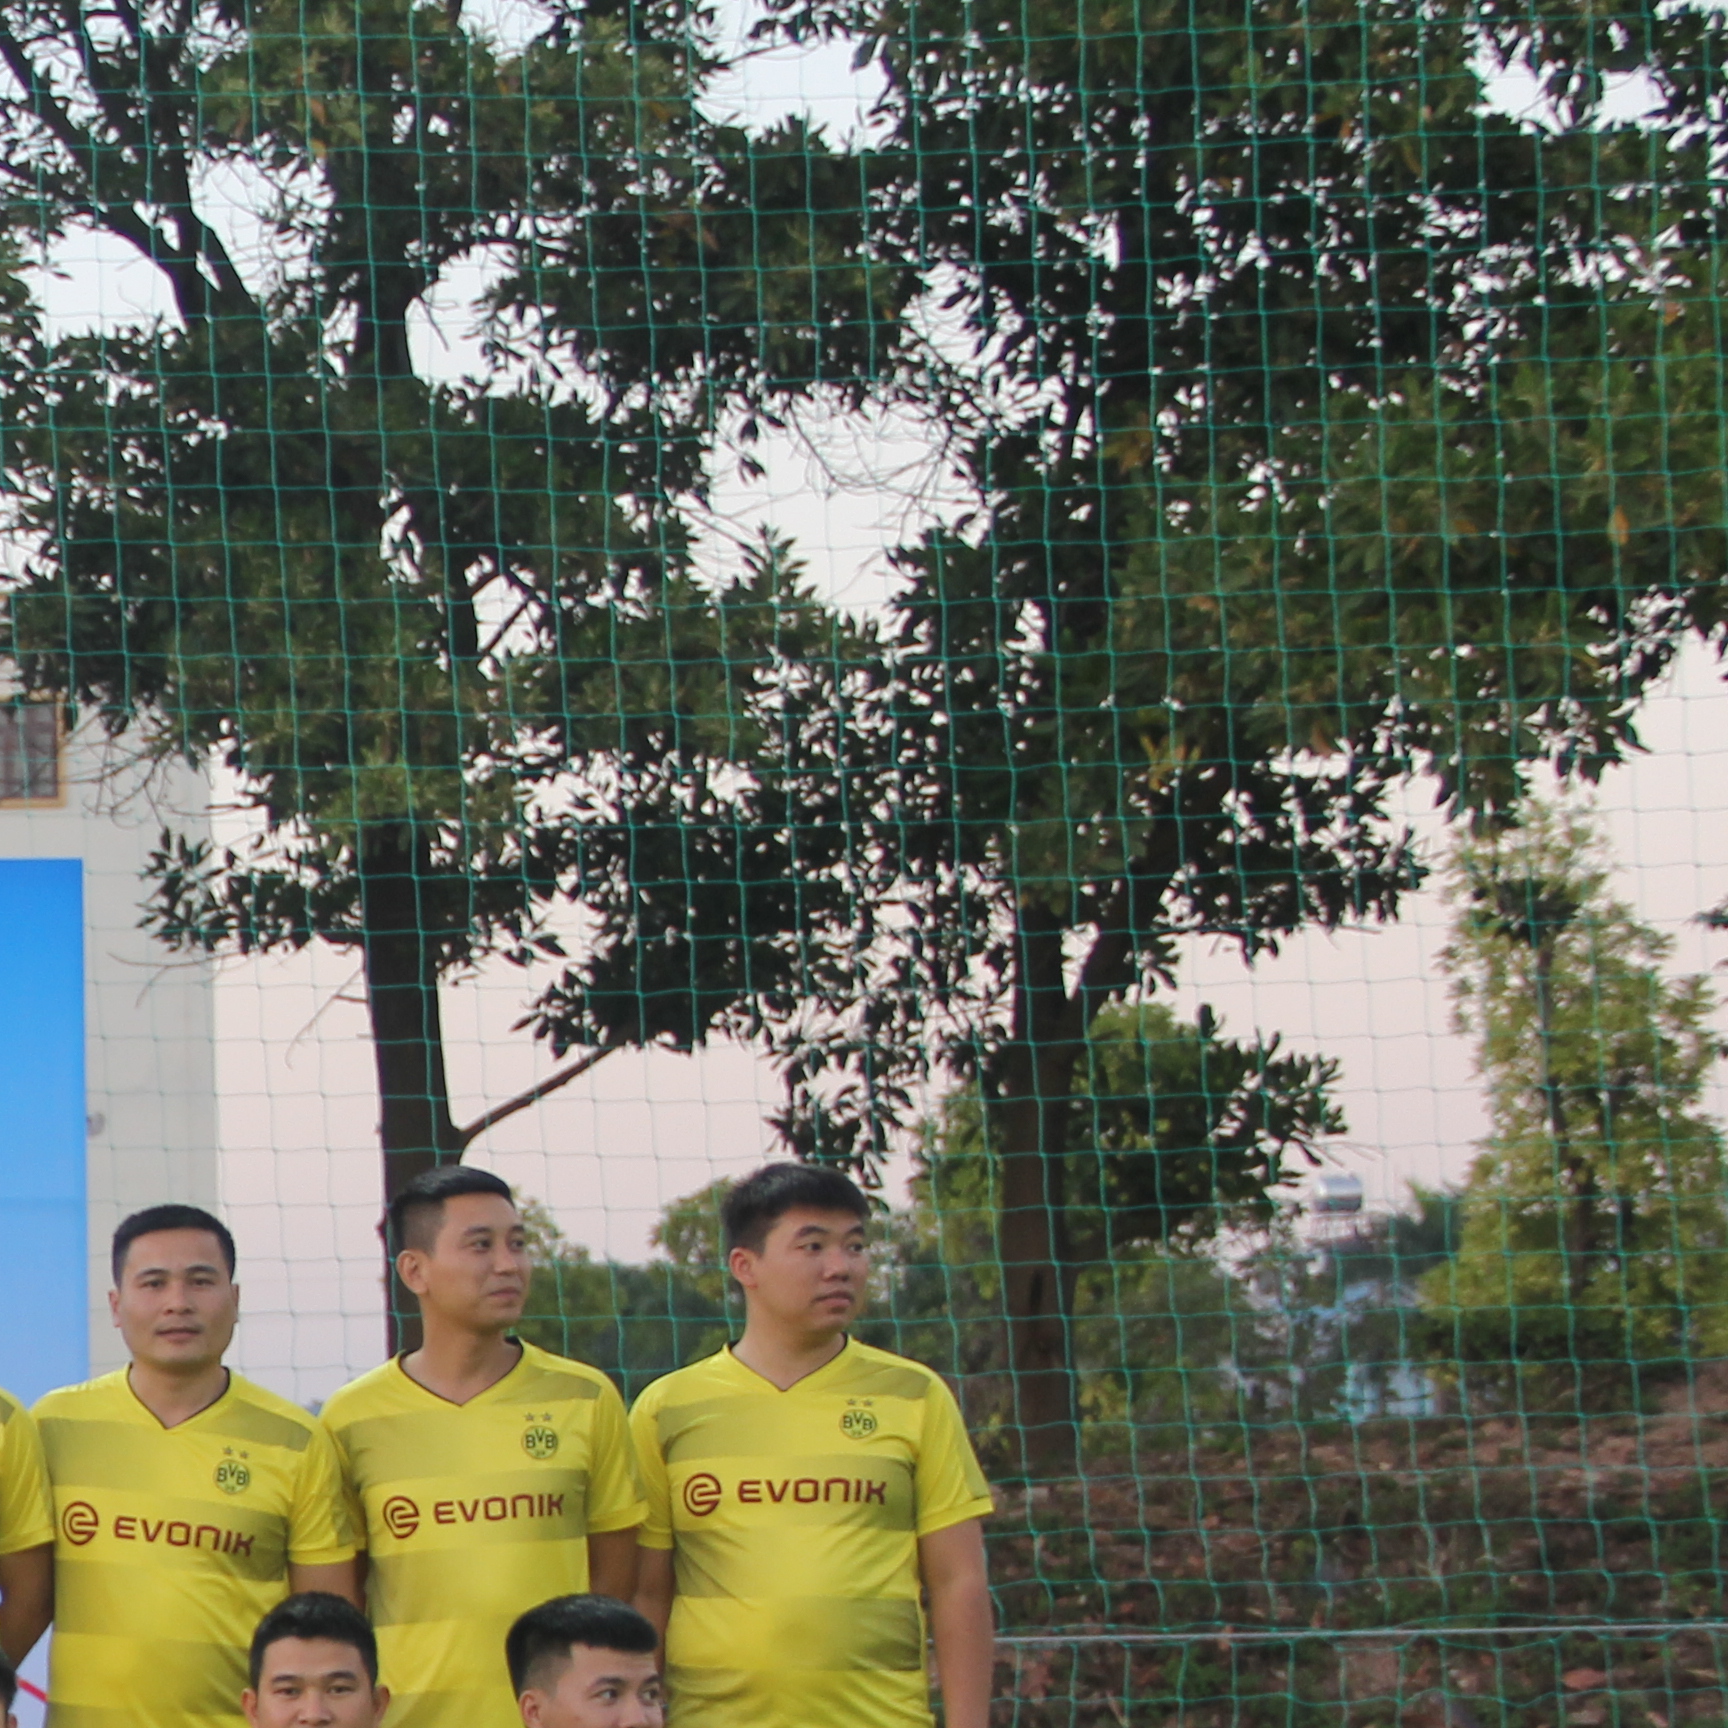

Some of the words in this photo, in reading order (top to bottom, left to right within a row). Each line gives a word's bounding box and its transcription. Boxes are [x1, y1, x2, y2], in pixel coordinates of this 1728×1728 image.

[842, 1411, 875, 1431] BVB
[525, 1426, 557, 1449] BVB
[216, 1462, 248, 1486] BVB
[737, 1477, 887, 1505] EVONIK
[433, 1493, 565, 1525] EVONIK
[113, 1516, 254, 1558] EVONIK
